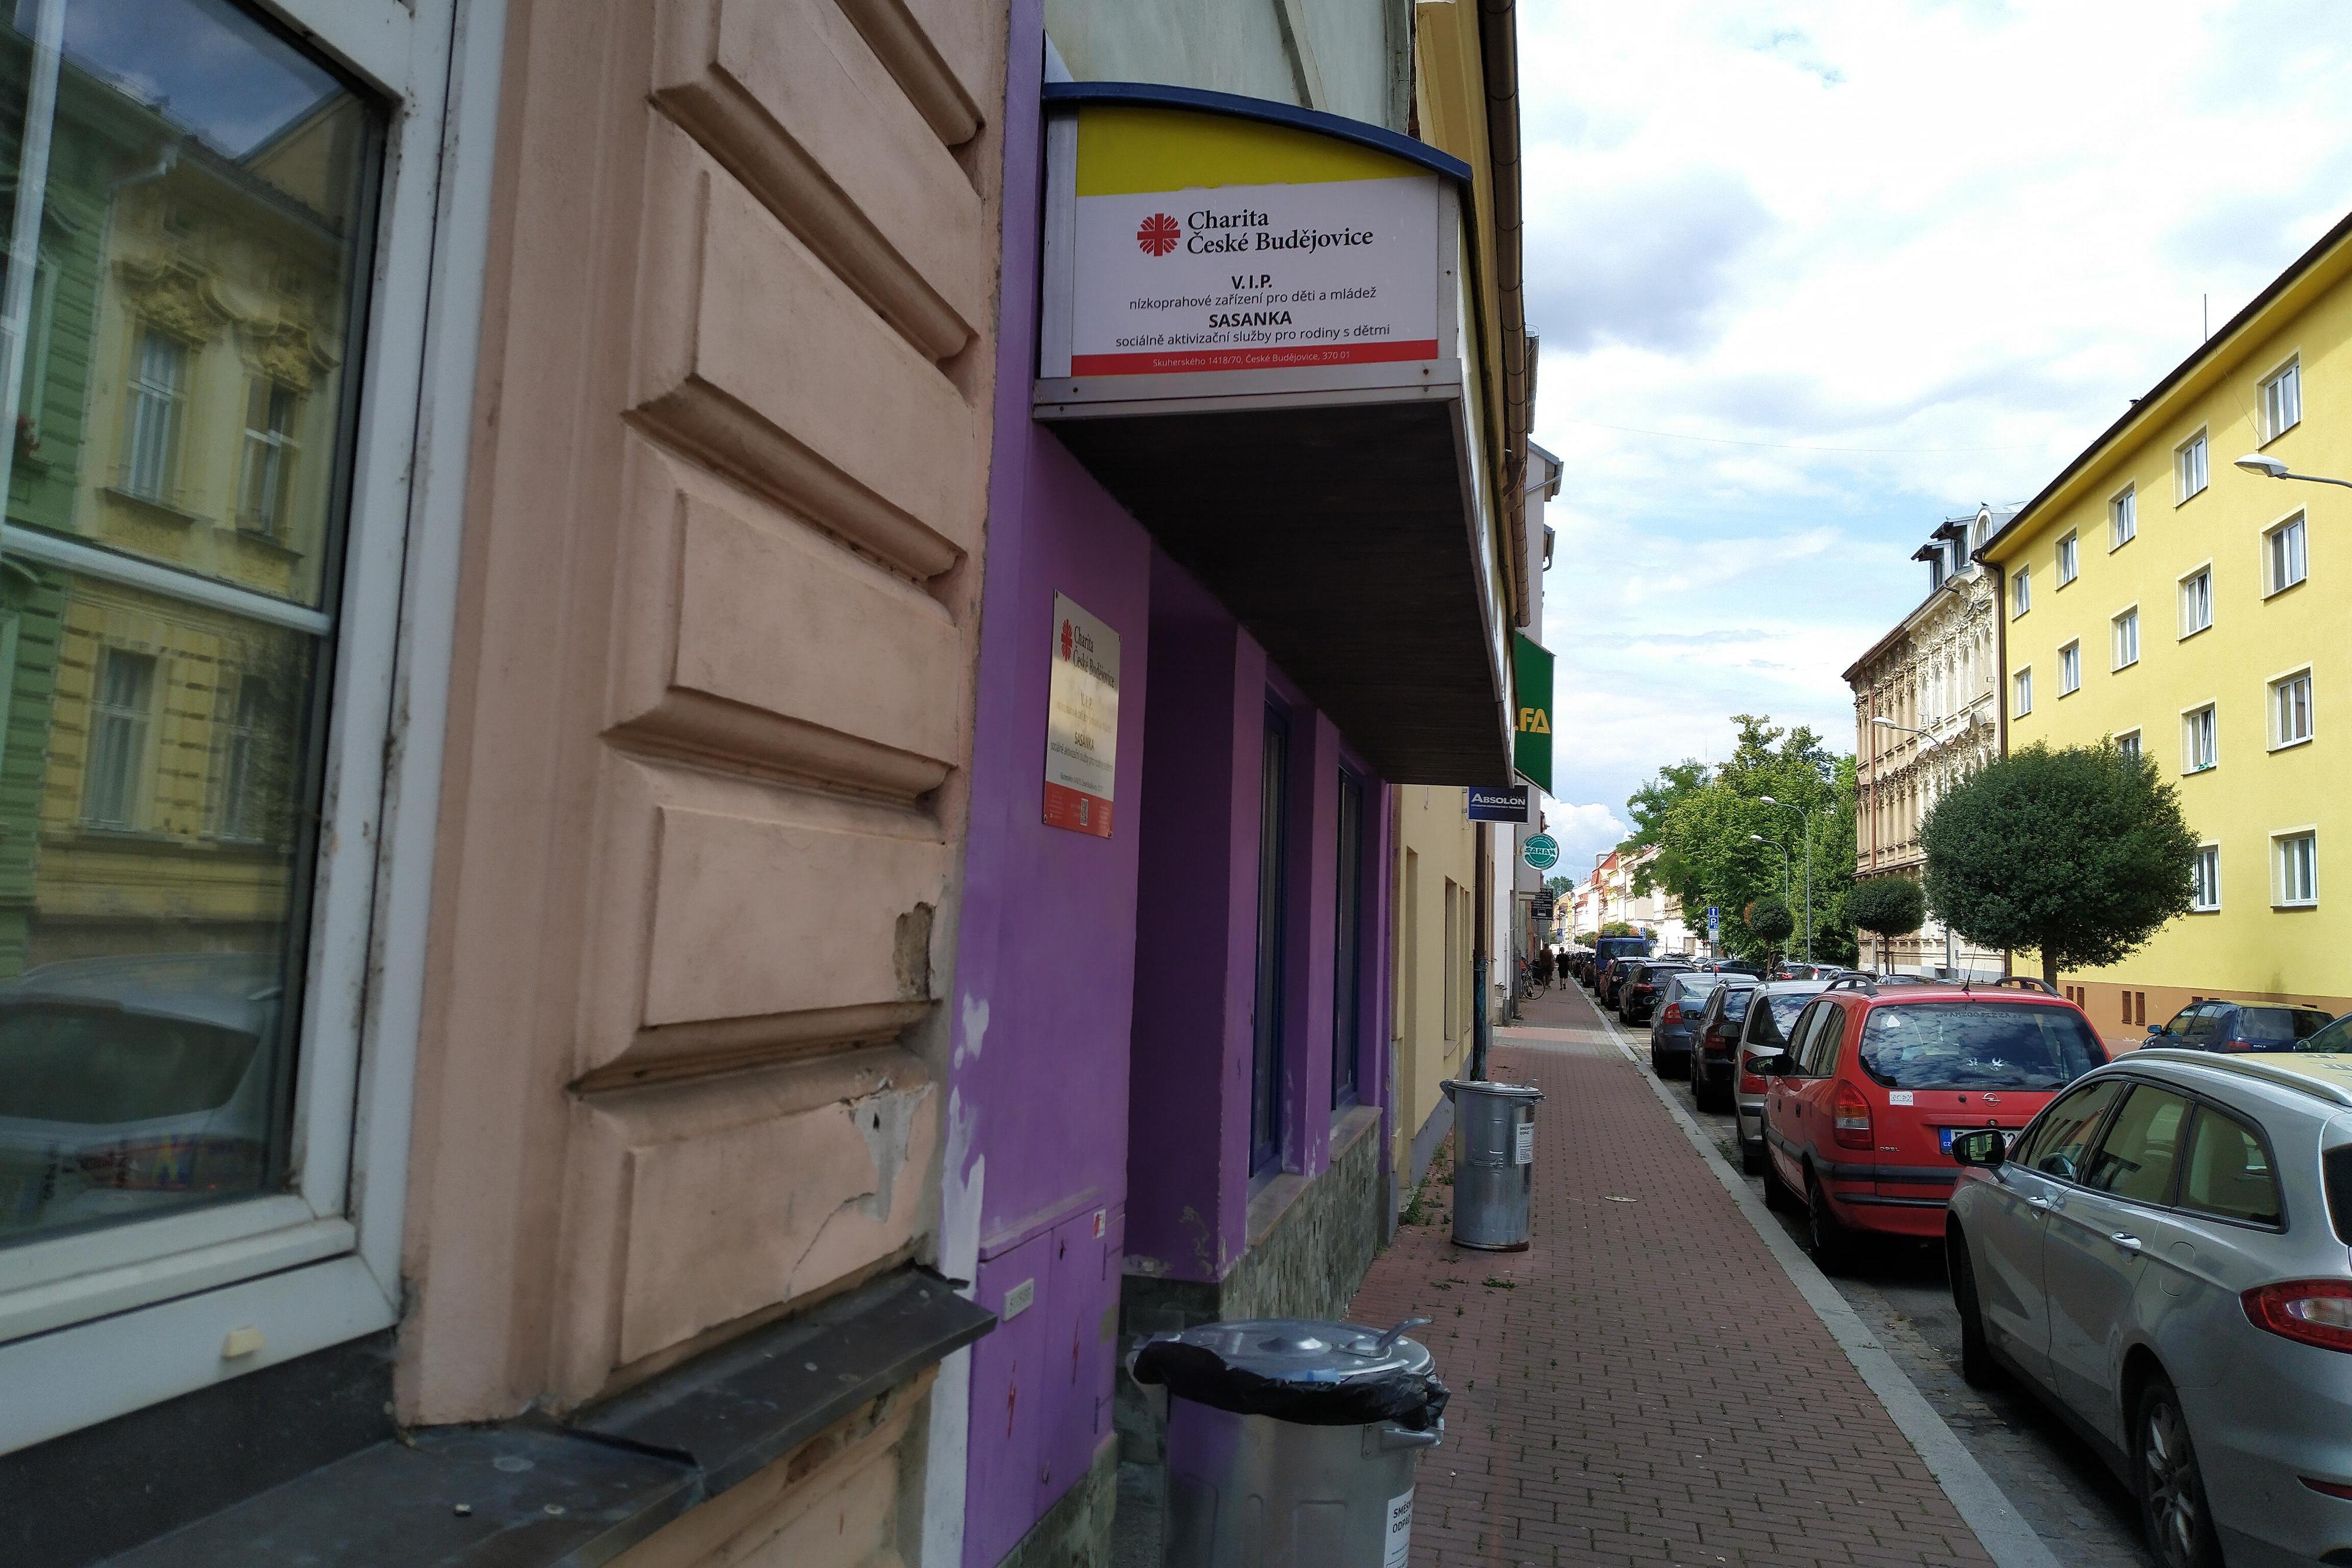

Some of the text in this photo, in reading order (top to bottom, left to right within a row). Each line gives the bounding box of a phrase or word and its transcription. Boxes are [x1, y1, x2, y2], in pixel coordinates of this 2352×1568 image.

[1188, 209, 1269, 230] Charita
[1187, 228, 1374, 255] České Budějovice
[1130, 286, 1377, 311] nízkoprahové zařízení pro děti a mládež
[1209, 310, 1292, 328] SASANKA
[1116, 324, 1390, 347] sociálně aktivizační služby pro rodiny s dětmi
[1153, 351, 1350, 367] Skuherského 1418/70, České Budějovice, 370 01
[1074, 626, 1094, 653] Charita
[1073, 646, 1114, 688] České Budějovice
[1515, 707, 1551, 734] FA
[1074, 731, 1094, 751] SASANKA
[1471, 793, 1526, 805] ABSOLON
[1710, 918, 1716, 926] P
